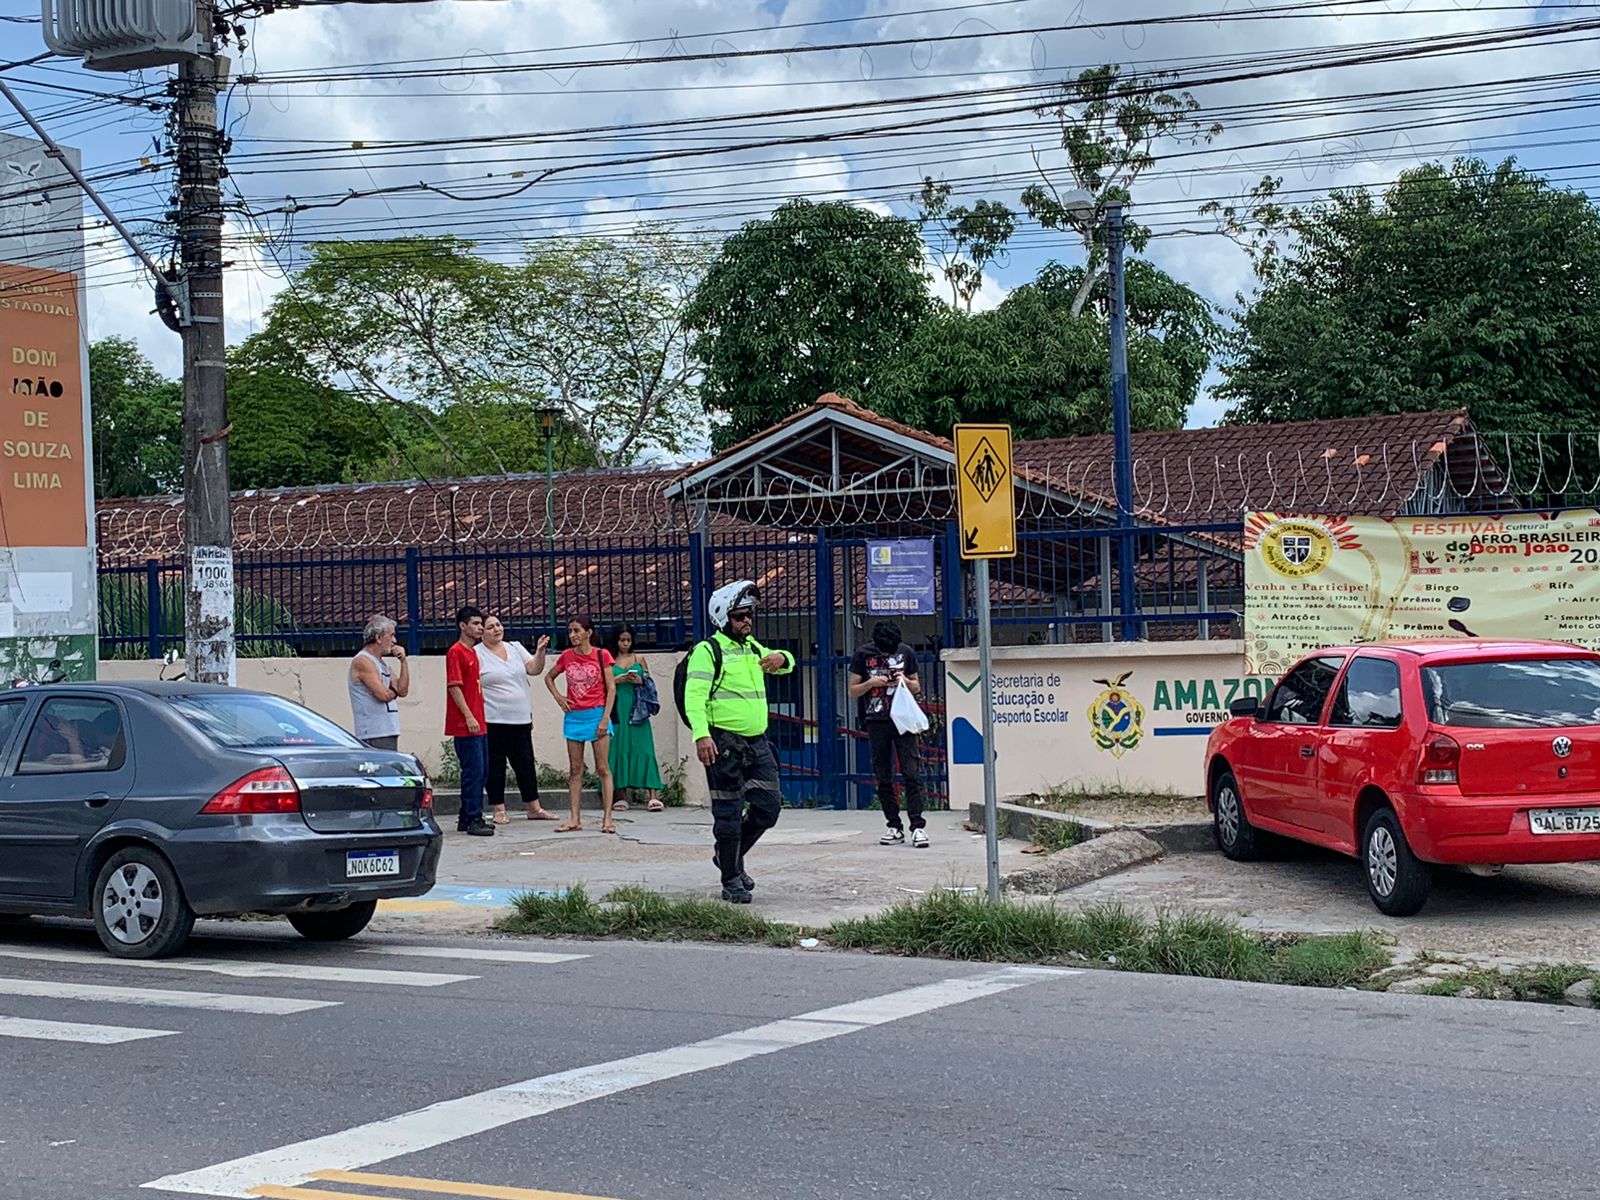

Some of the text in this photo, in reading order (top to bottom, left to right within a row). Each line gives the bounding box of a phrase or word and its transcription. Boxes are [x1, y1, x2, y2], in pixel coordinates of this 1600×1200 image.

[12, 347, 57, 367] DOM
[9, 376, 64, 398] JOÃO
[24, 410, 49, 427] DE
[3, 441, 72, 460] SOUZA
[14, 472, 62, 488] LIMA
[1412, 522, 1549, 535] FESTIVAL Cultural
[1446, 540, 1570, 557] do Dom João
[1570, 548, 1600, 564] 20
[1245, 583, 1285, 592] Venha
[1302, 583, 1369, 593] Participe!
[1425, 583, 1459, 592] Bingo
[1549, 582, 1574, 590] Rifa
[1271, 613, 1320, 622] Atrações
[992, 672, 1061, 688] Secretaria de
[992, 691, 1055, 708] Educação e
[992, 708, 1069, 726] Desporto Escolar
[1185, 712, 1230, 723] GOVERNO
